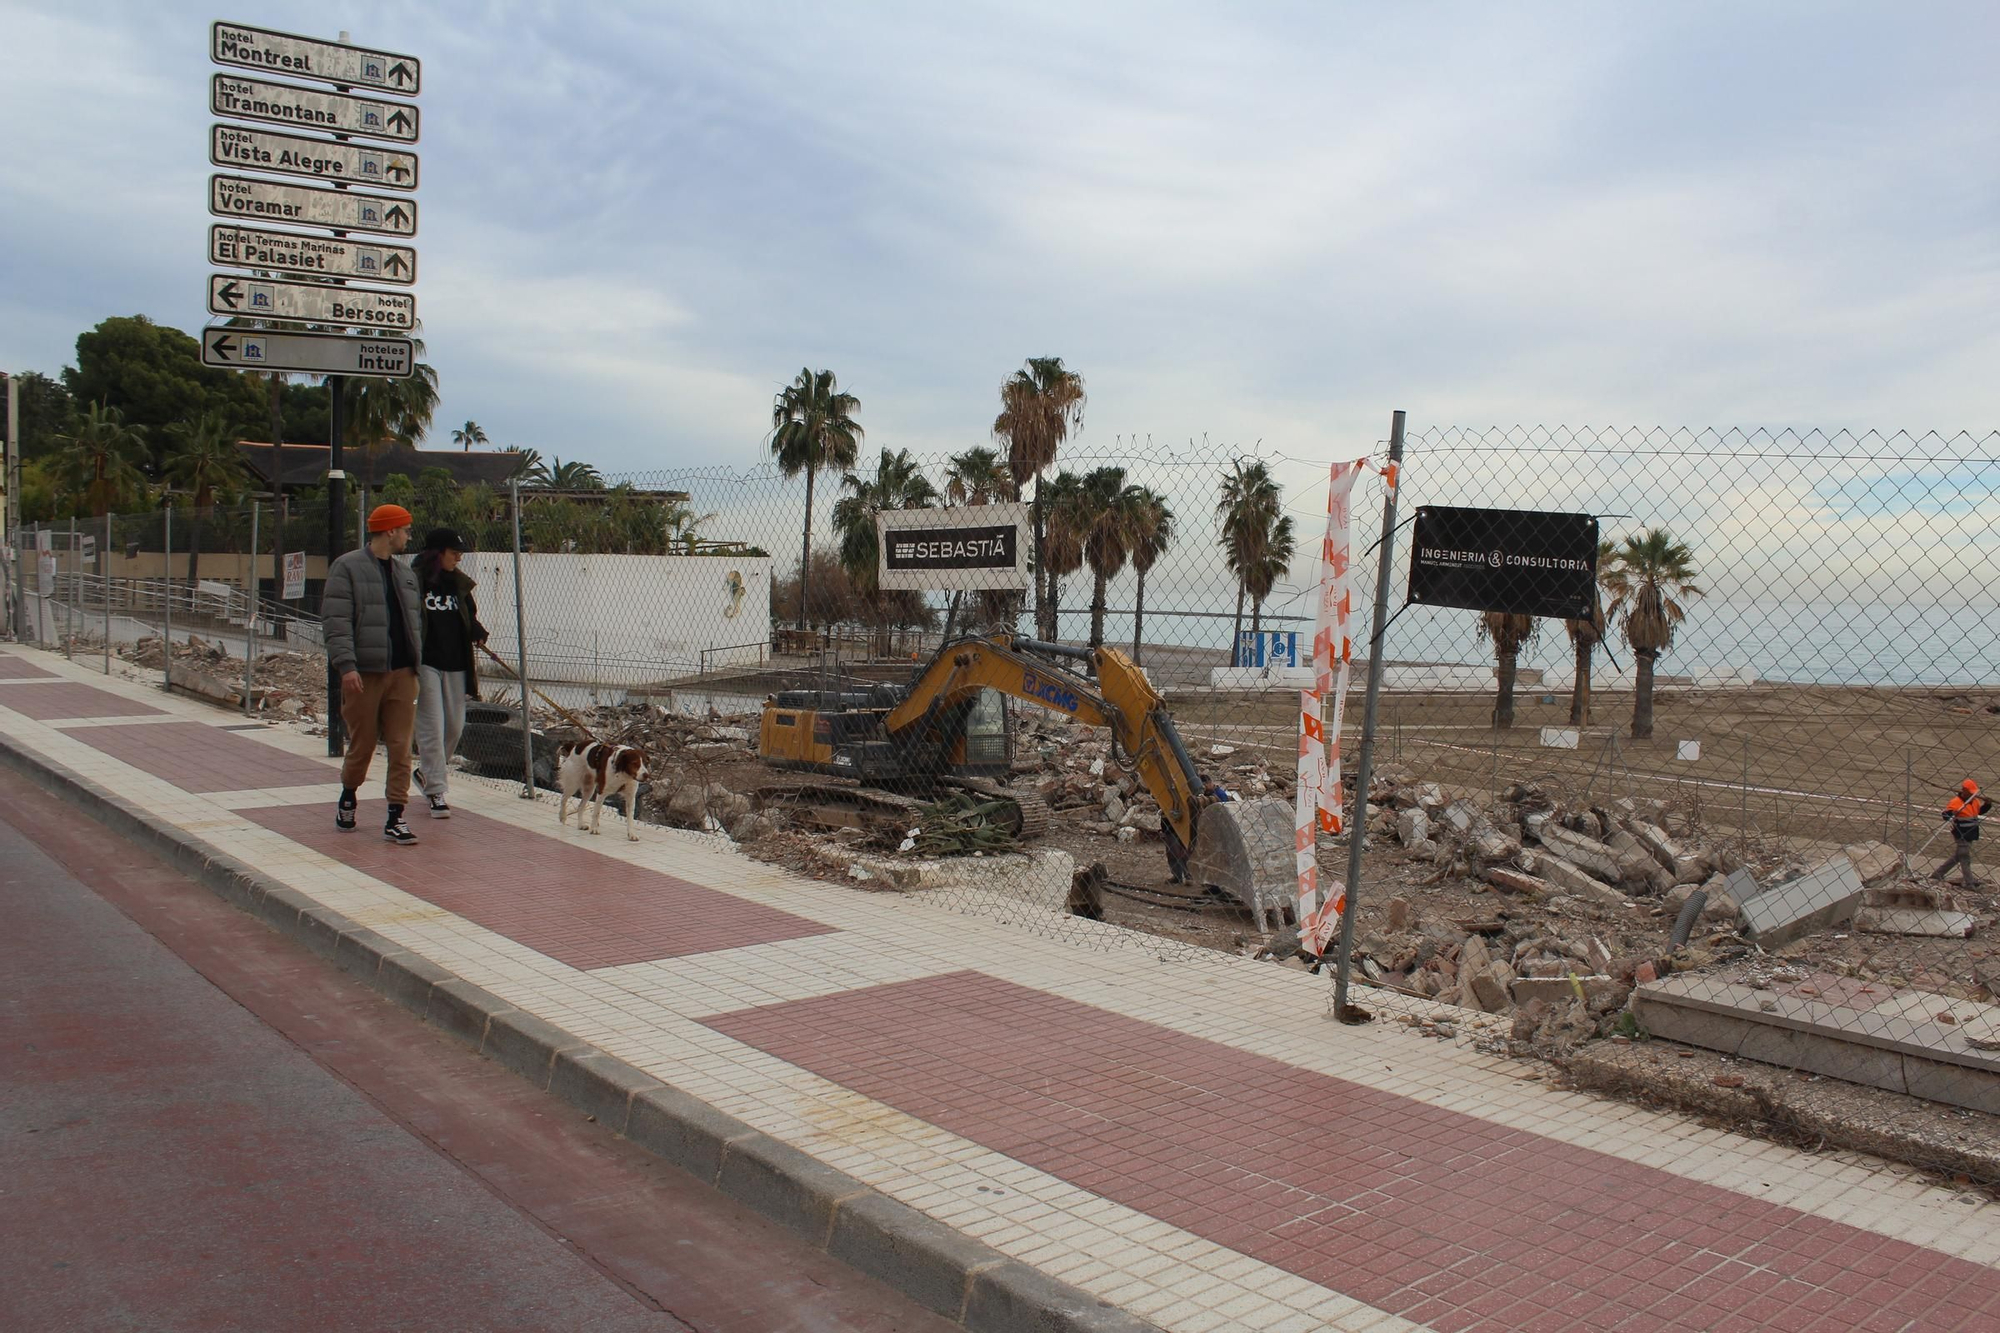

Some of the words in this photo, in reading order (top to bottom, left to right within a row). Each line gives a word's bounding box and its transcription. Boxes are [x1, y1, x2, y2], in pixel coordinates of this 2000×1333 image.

[221, 29, 254, 44] hotel
[221, 40, 311, 71] Montreal
[220, 80, 253, 94] hotel
[220, 92, 337, 124] Tramontana
[220, 130, 253, 144] hotel
[220, 141, 272, 163] Vista
[279, 151, 344, 173] Alegre
[219, 181, 252, 195] hotel
[219, 193, 302, 217] Voramar
[219, 231, 251, 244] hotel
[256, 235, 298, 249] Termas
[301, 241, 346, 255] Marinas
[219, 242, 238, 259] El
[245, 245, 325, 269] Palasiet
[332, 303, 407, 324] Bersoca
[378, 297, 408, 309] hotel
[360, 344, 405, 355] hoteles
[358, 355, 404, 371] Intur
[1420, 547, 1486, 563] INGENIERIA
[1506, 555, 1589, 571] CONSULTORIA
[1035, 681, 1079, 712] XCMG
